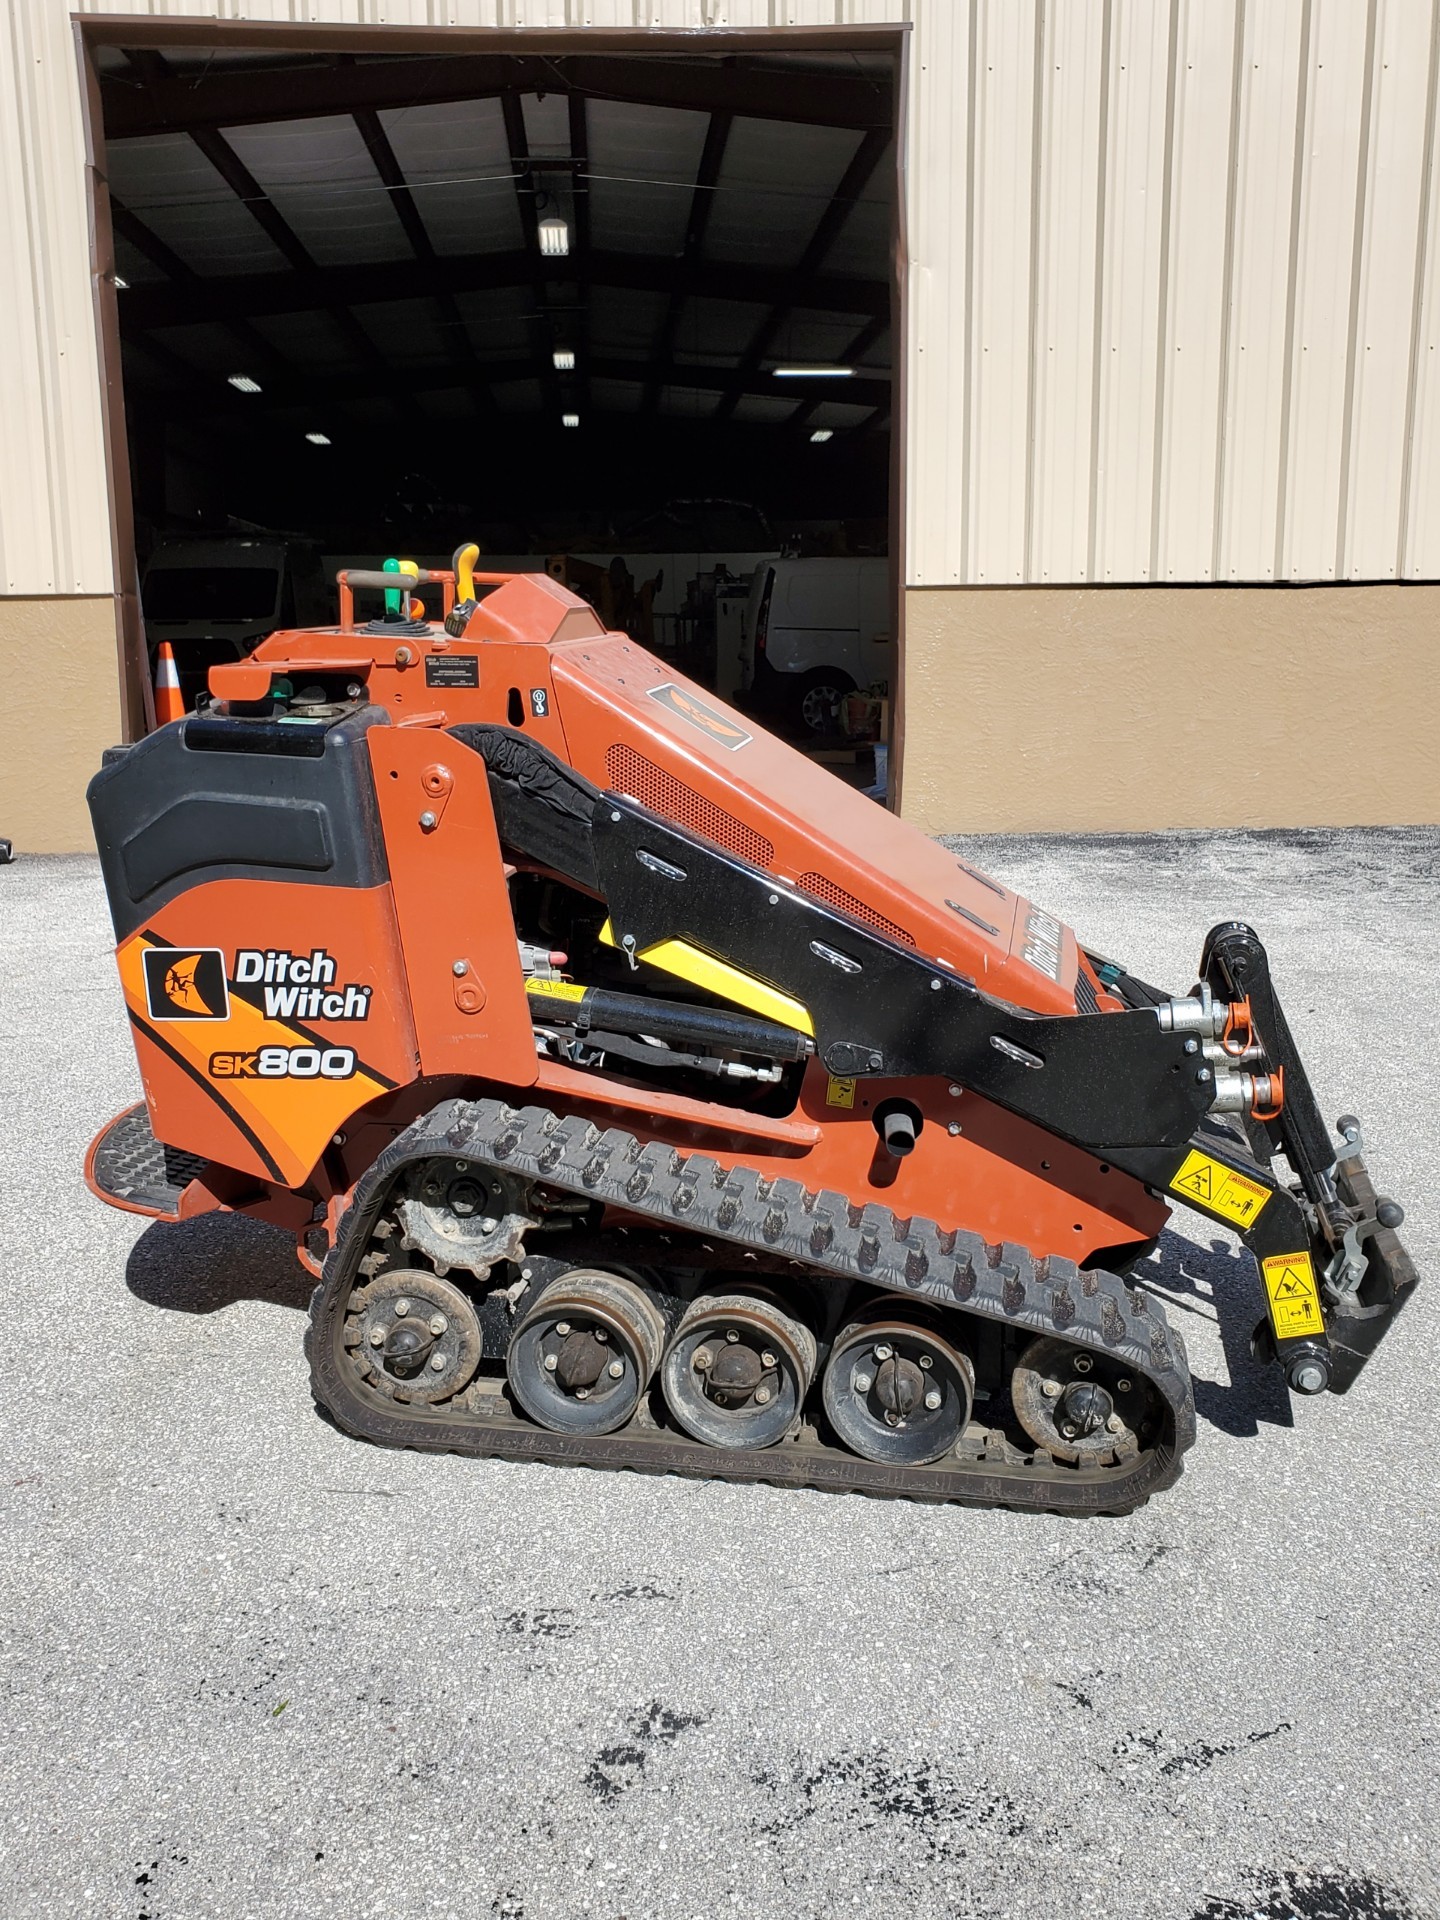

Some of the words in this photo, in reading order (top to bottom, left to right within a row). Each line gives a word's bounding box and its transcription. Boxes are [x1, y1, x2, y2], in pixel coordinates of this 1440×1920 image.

[235, 951, 335, 983] Ditch
[263, 986, 369, 1018] Witch
[211, 1048, 355, 1077] SK800
[1236, 1176, 1266, 1197] WARNING
[1272, 1255, 1306, 1267] WARNING
